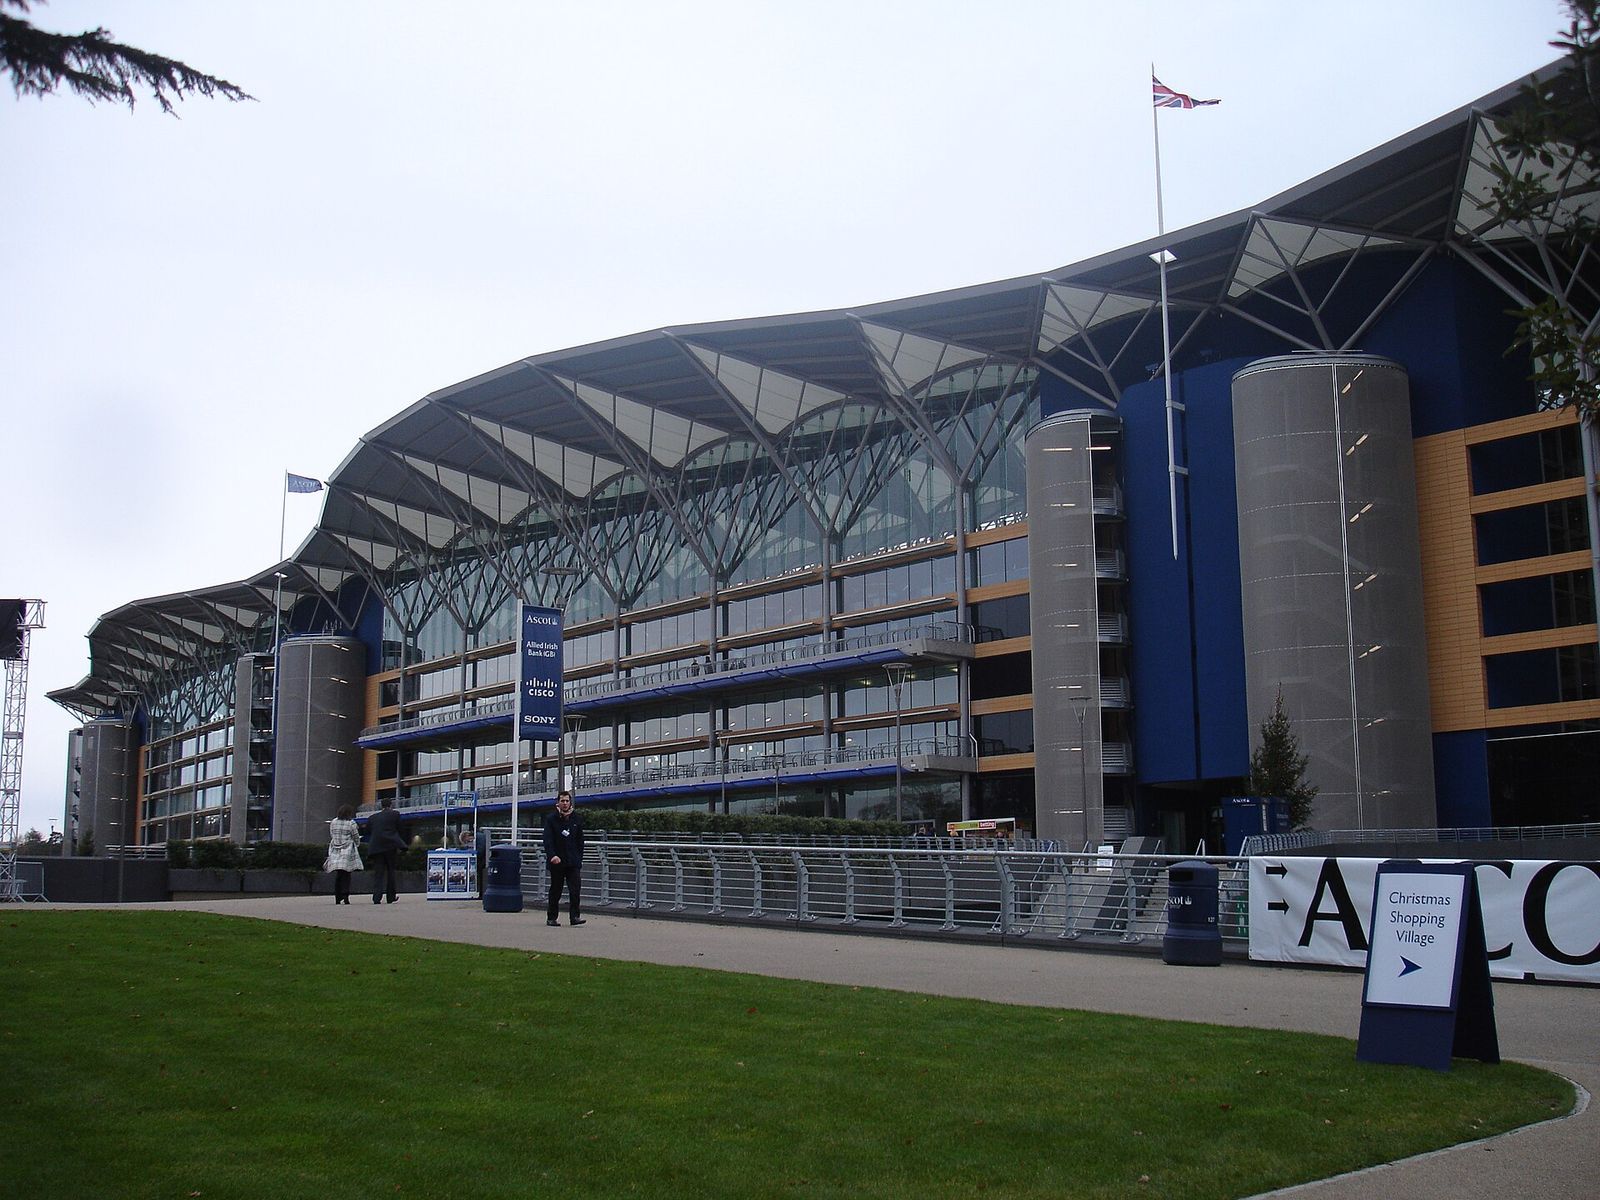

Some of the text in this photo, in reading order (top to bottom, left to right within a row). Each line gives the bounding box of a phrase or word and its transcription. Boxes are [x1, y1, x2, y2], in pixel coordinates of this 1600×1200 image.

[526, 641, 558, 650] Allied Irish
[528, 649, 543, 657] Bank
[524, 714, 556, 724] SONY
[1389, 891, 1451, 906] Christmas
[1297, 858, 1600, 966] AO
[1390, 910, 1446, 929] Shopping
[1396, 930, 1435, 947] Village
